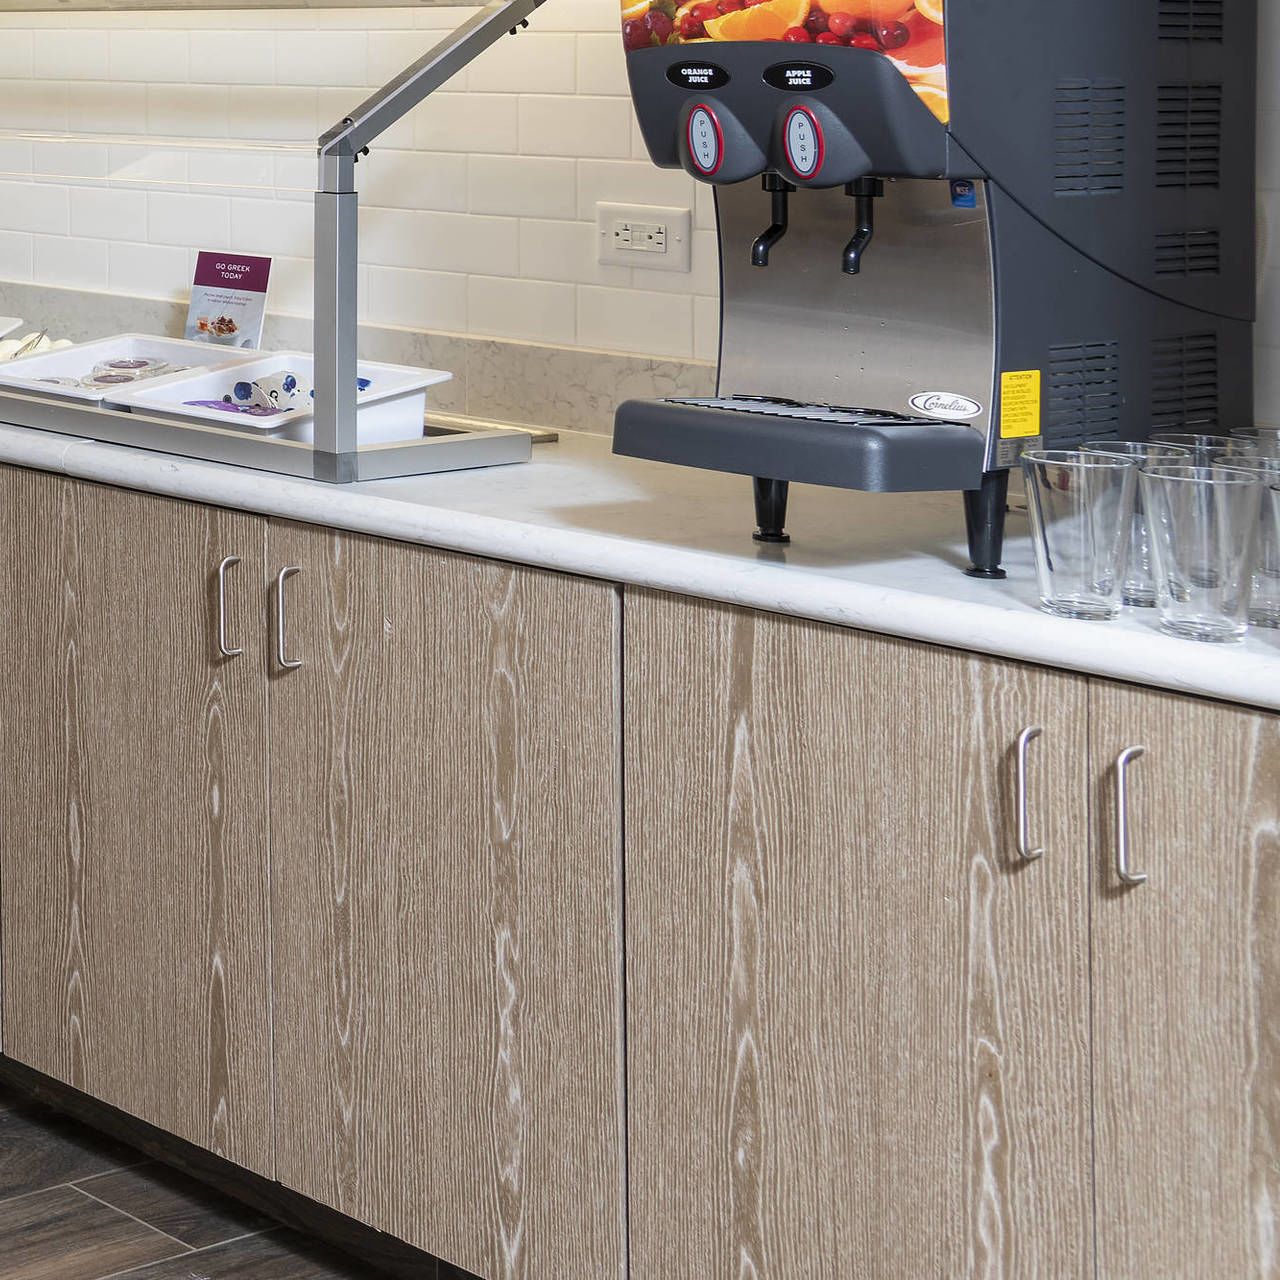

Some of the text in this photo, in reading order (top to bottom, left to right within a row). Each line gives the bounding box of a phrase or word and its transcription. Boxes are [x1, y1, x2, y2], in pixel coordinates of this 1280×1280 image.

[680, 68, 714, 76] ORANGE
[785, 70, 812, 78] APPLE
[788, 77, 812, 85] JUICE
[699, 119, 710, 159] PUSH
[798, 122, 807, 162] PUSH
[215, 262, 251, 272] GO GREEK
[220, 271, 243, 280] TODAY
[923, 394, 969, 412] Cornelius
